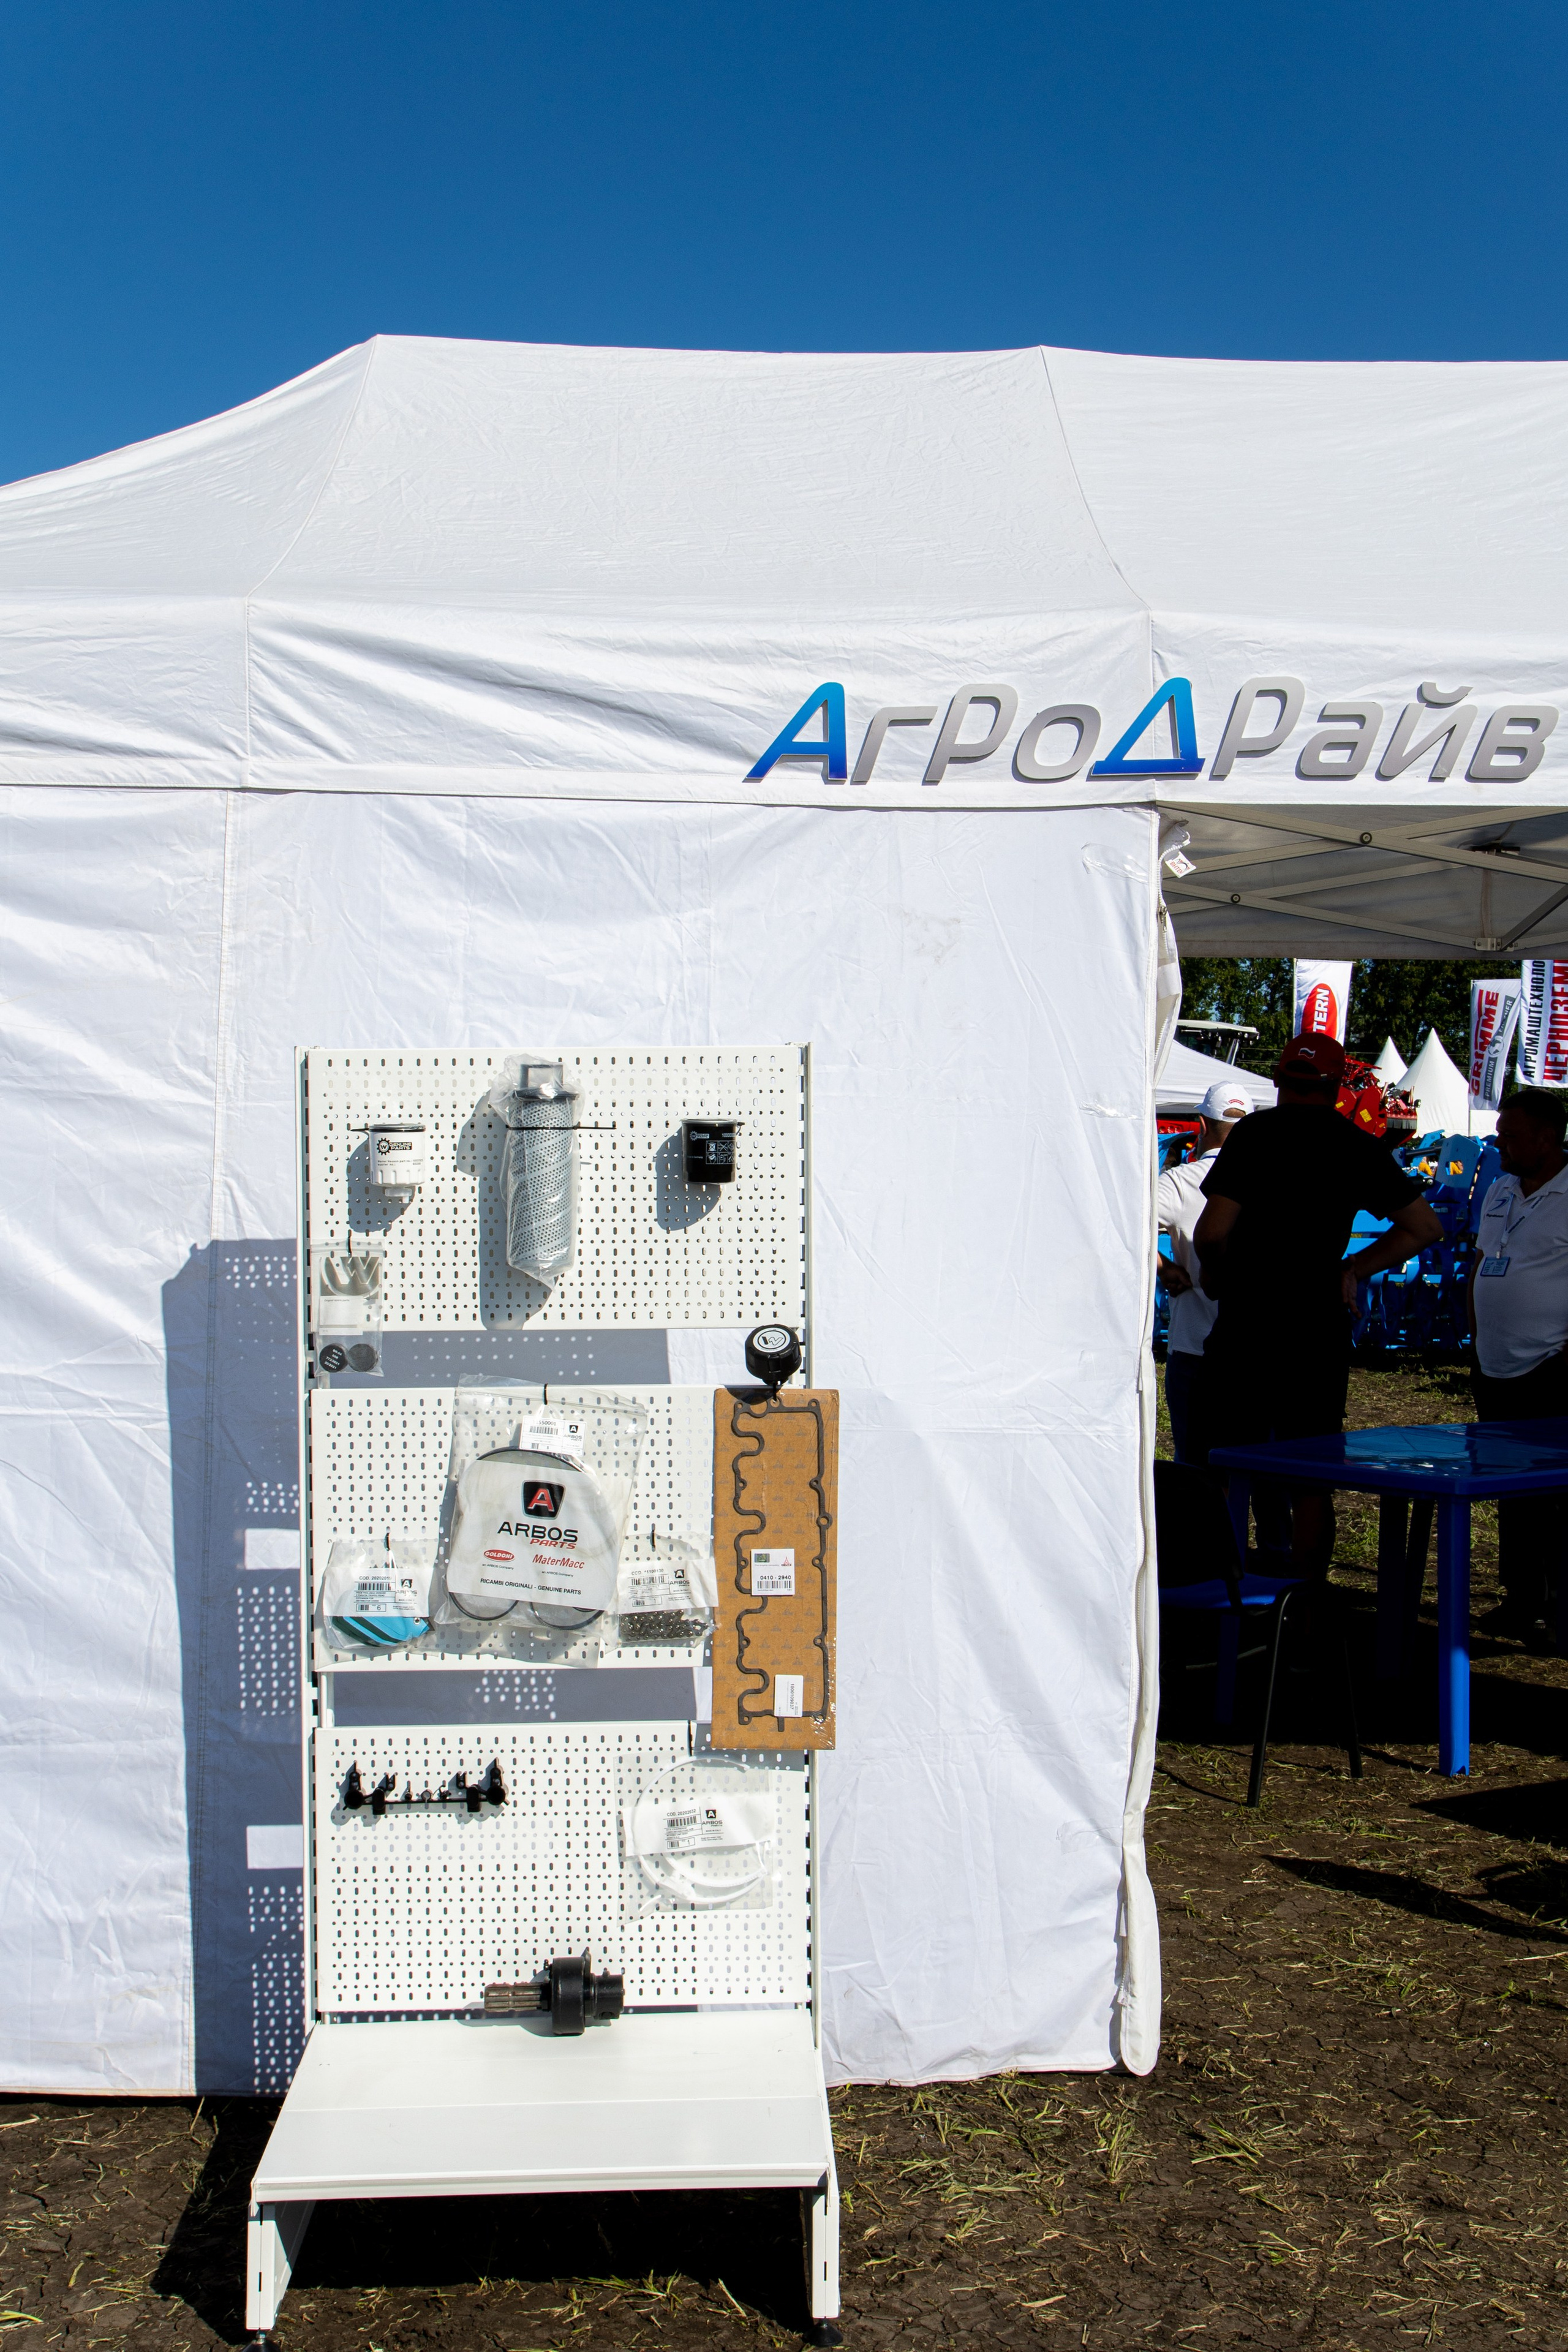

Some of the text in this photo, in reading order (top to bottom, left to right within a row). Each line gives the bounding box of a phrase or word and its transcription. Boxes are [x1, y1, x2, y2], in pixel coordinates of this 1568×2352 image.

[1544, 960, 1568, 1080] ЧЕРНОЗЕМ
[1471, 989, 1499, 1096] GRIMME
[1485, 1060, 1494, 1097] PREMIUM
[497, 1521, 579, 1543] ARBOS
[529, 1538, 577, 1550] PARTS
[532, 1554, 585, 1569] MaterMacc
